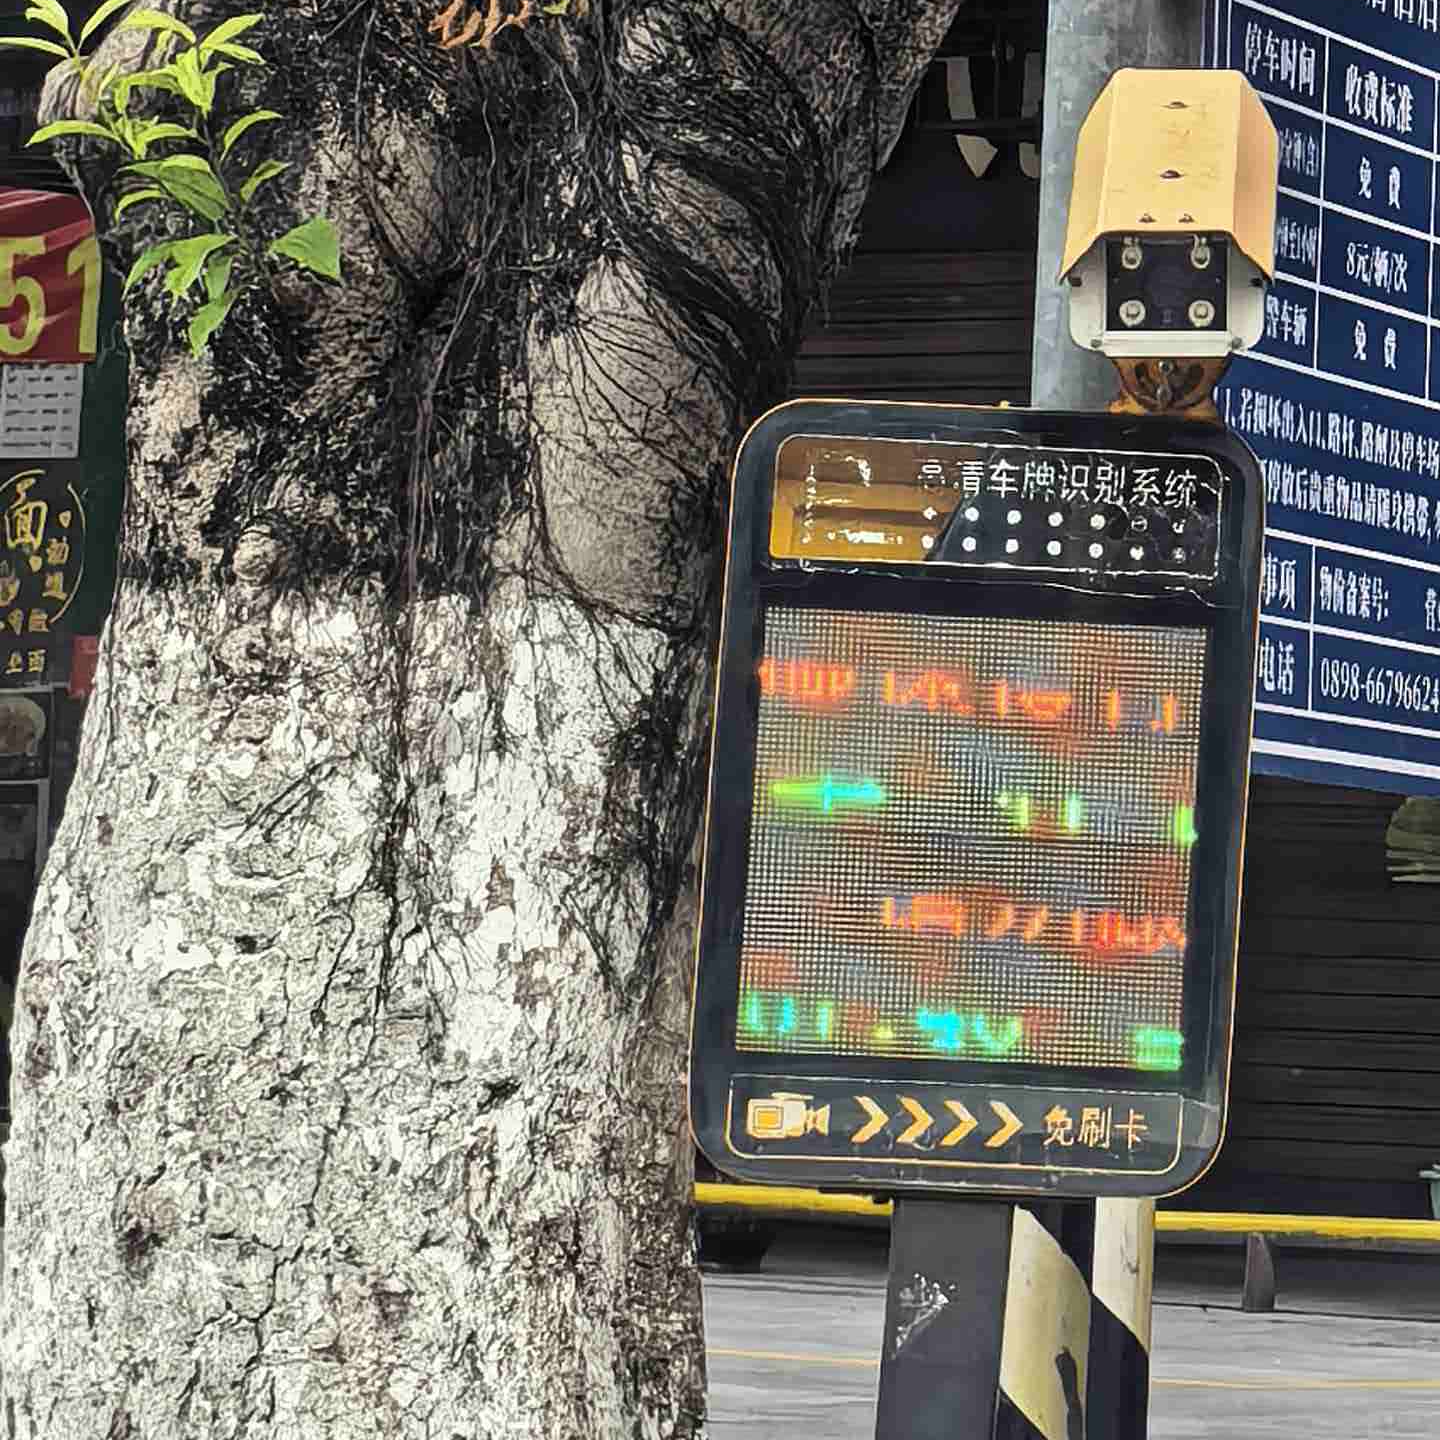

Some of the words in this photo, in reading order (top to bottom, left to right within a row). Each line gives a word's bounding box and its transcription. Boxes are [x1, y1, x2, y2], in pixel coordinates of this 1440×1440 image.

[1244, 21, 1317, 97] 停车时间
[1345, 62, 1415, 136] 收费标准
[1041, 1103, 1151, 1151] 免刷卡
